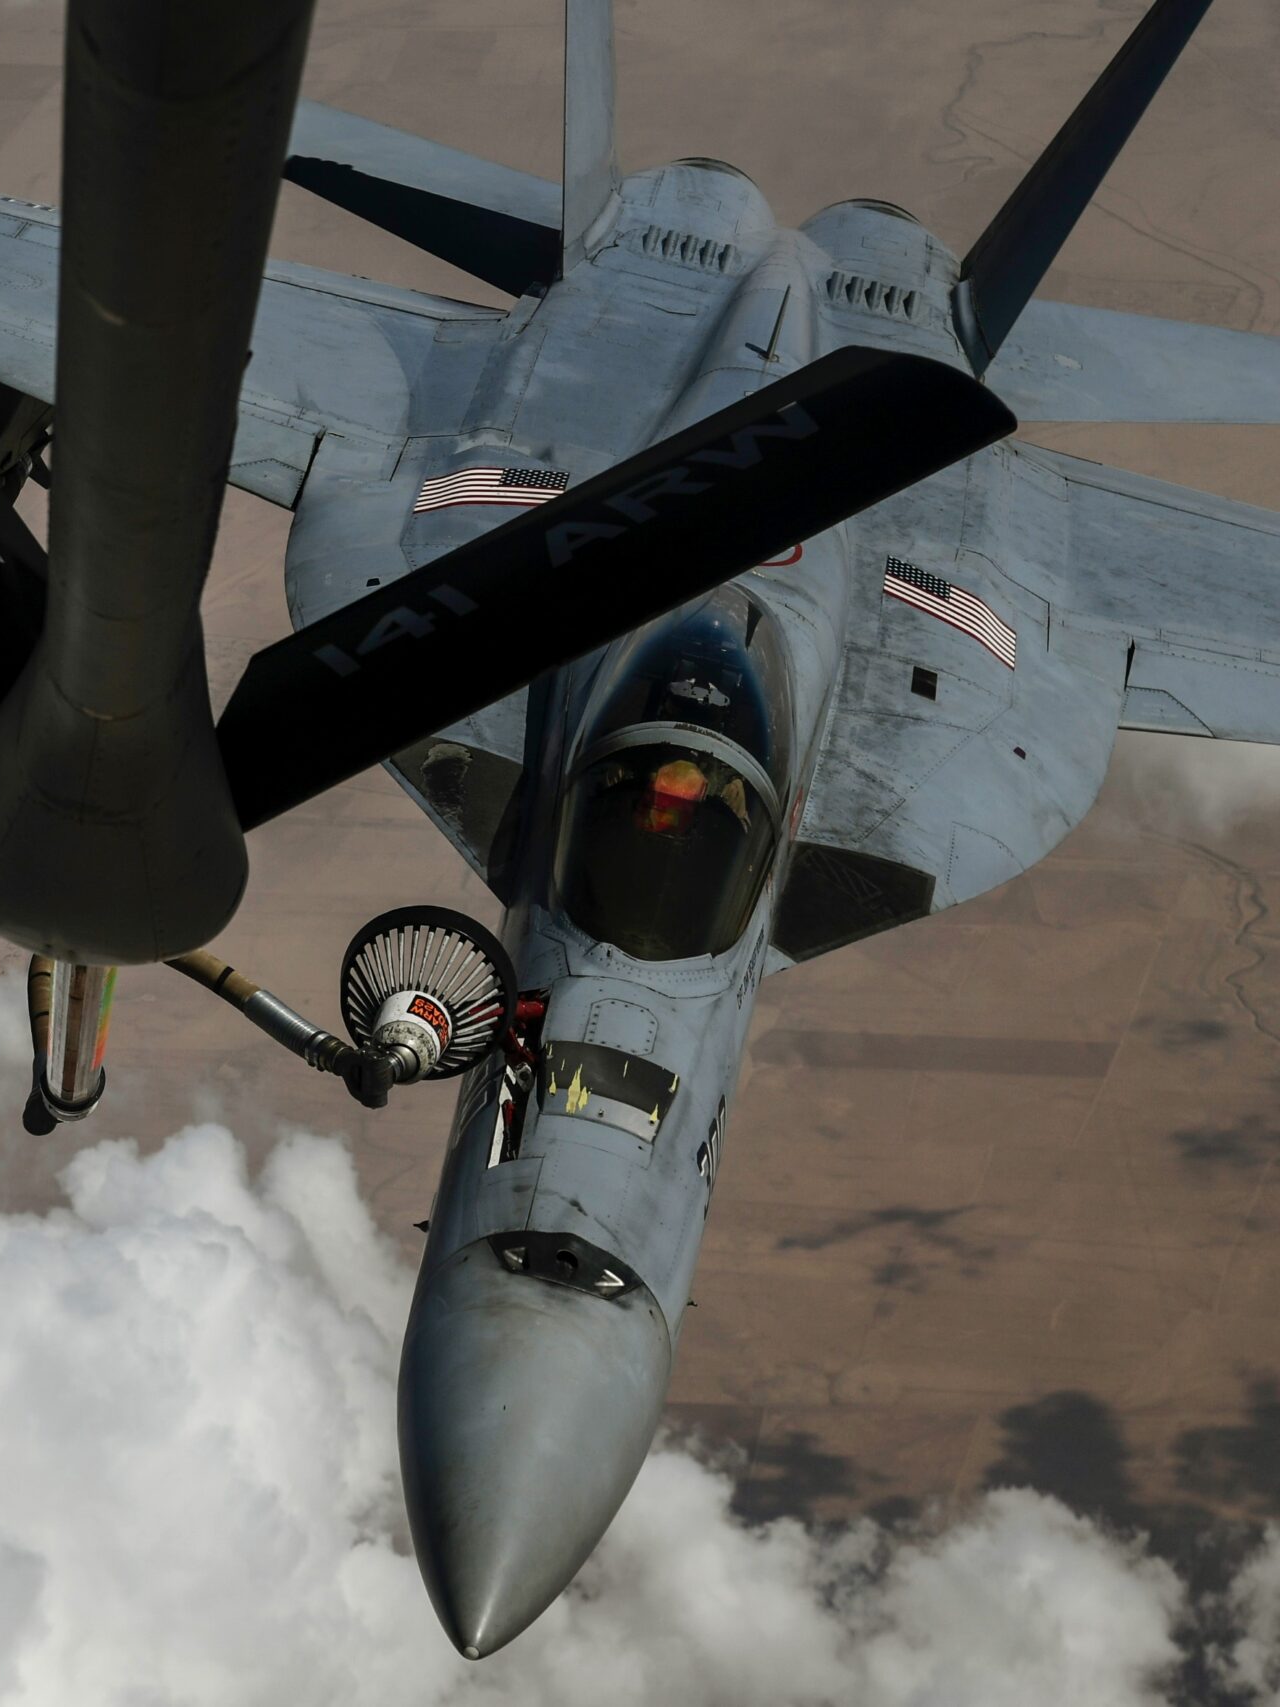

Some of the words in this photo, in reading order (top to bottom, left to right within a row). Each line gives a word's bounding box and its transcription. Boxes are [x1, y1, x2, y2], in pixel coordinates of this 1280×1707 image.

[314, 583, 479, 677] 141
[546, 401, 820, 568] ARW
[410, 1005, 439, 1026] ARW
